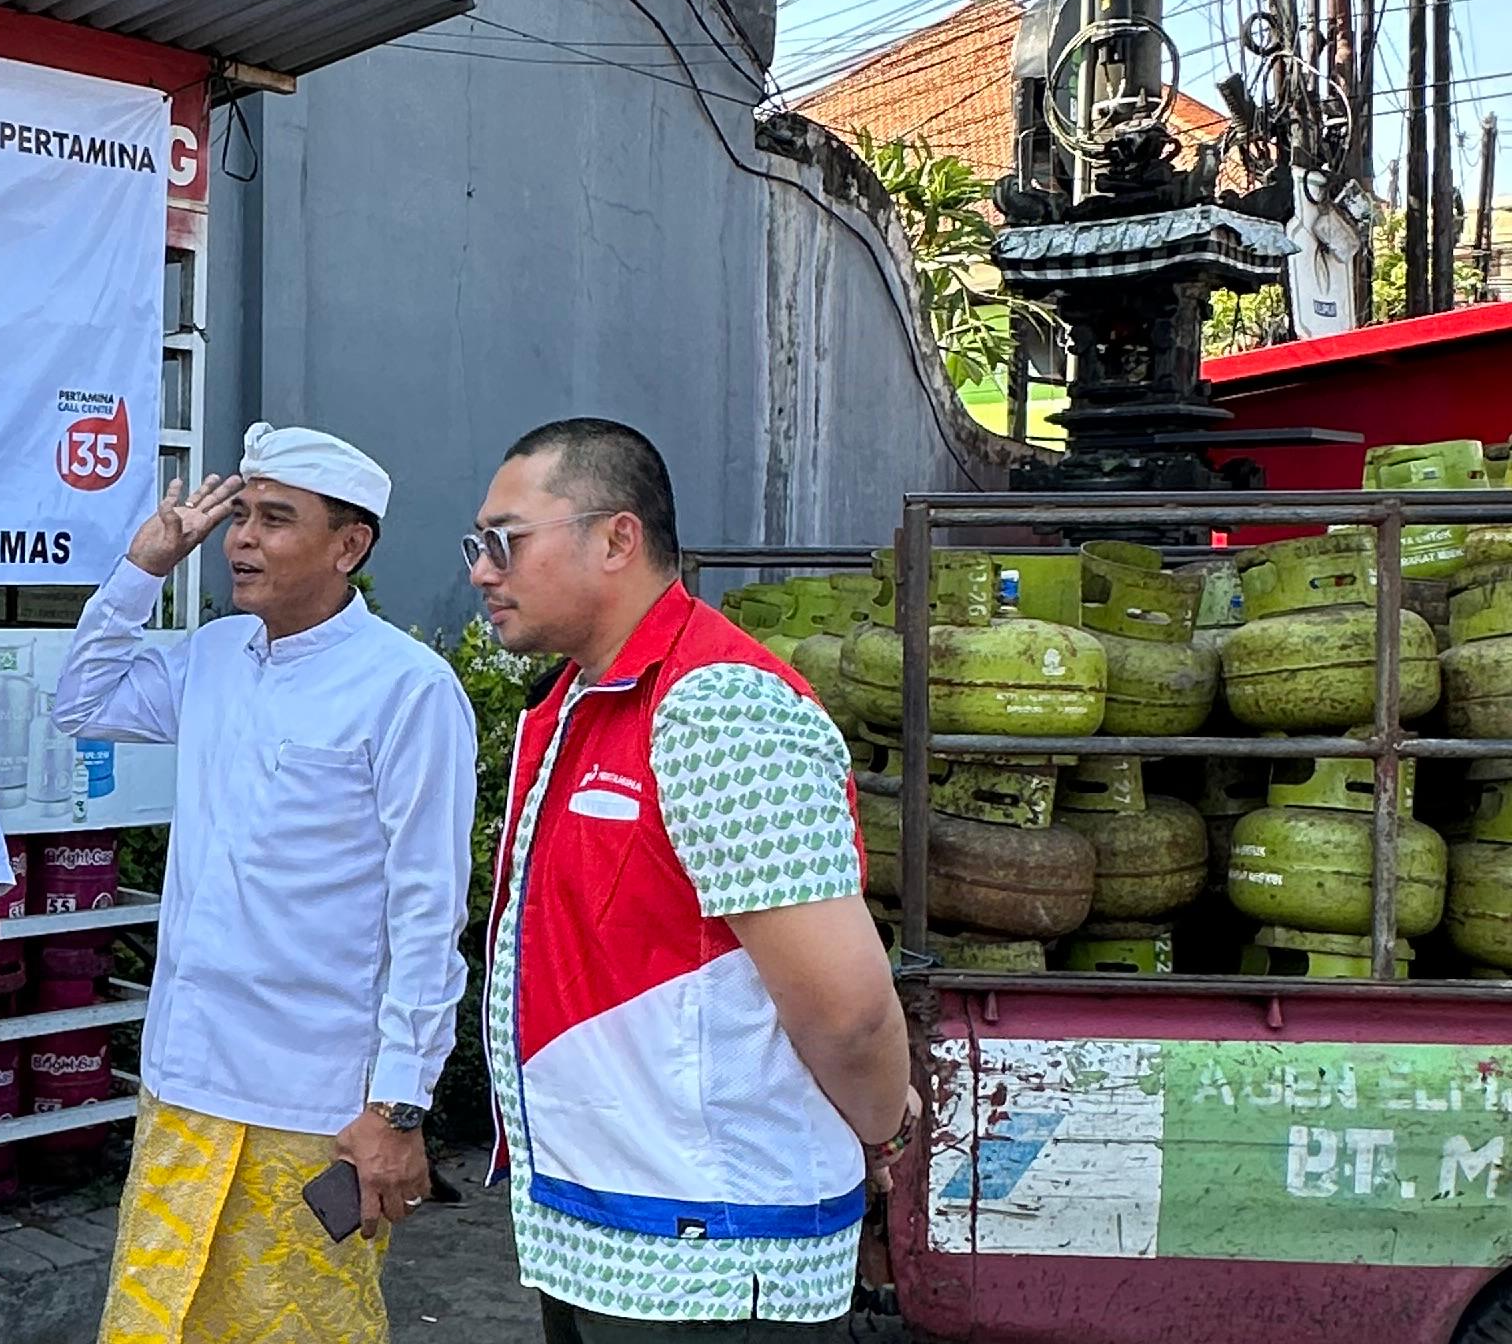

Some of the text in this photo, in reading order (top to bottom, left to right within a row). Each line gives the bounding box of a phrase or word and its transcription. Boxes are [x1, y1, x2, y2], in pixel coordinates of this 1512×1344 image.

[0, 120, 157, 174] PERTAMINA
[57, 402, 80, 413] CALL
[58, 389, 114, 404] PERTAMINA
[60, 431, 120, 478] 135
[1287, 1125, 1416, 1199] PT.
